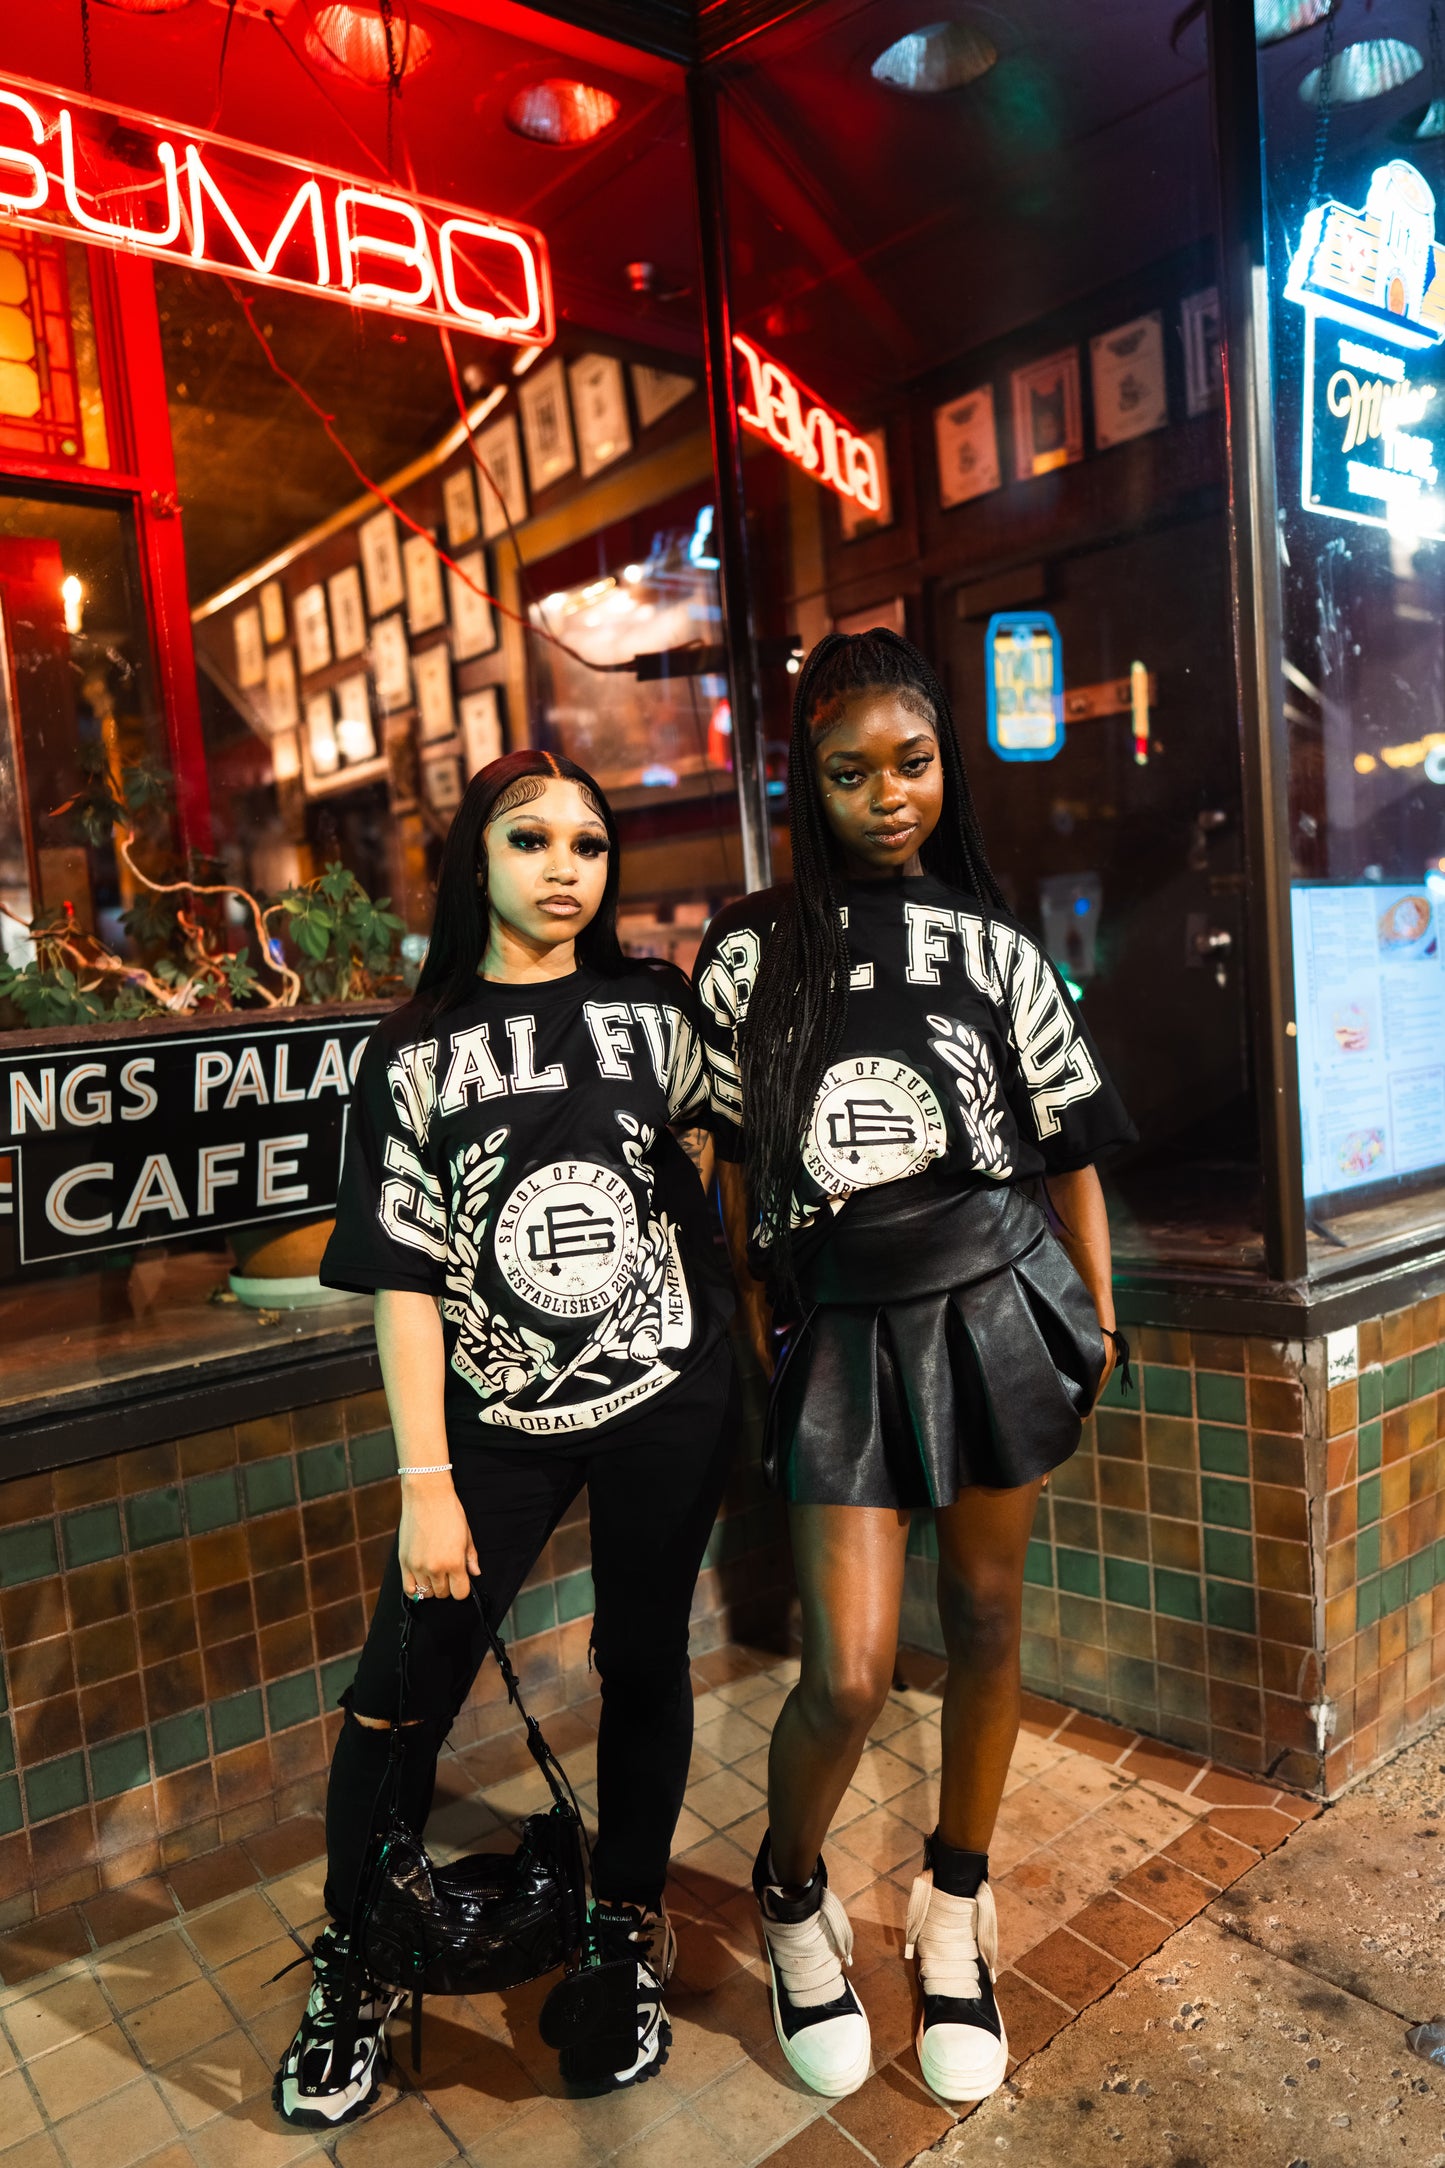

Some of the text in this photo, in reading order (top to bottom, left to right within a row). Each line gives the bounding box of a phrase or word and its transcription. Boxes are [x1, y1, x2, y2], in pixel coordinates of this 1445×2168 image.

[904, 902, 1102, 1141] FUNDZ
[856, 1062, 879, 1075] OF
[893, 1068, 942, 1131] FUNDZ
[45, 1133, 309, 1237] CAFE
[499, 1180, 541, 1243] SKOOL
[553, 1166, 577, 1181] OF
[592, 1170, 635, 1228] FUNDZ
[507, 1251, 635, 1314] ESTABLISHED 2024
[492, 1375, 663, 1431] GLOBAL FUNDZ
